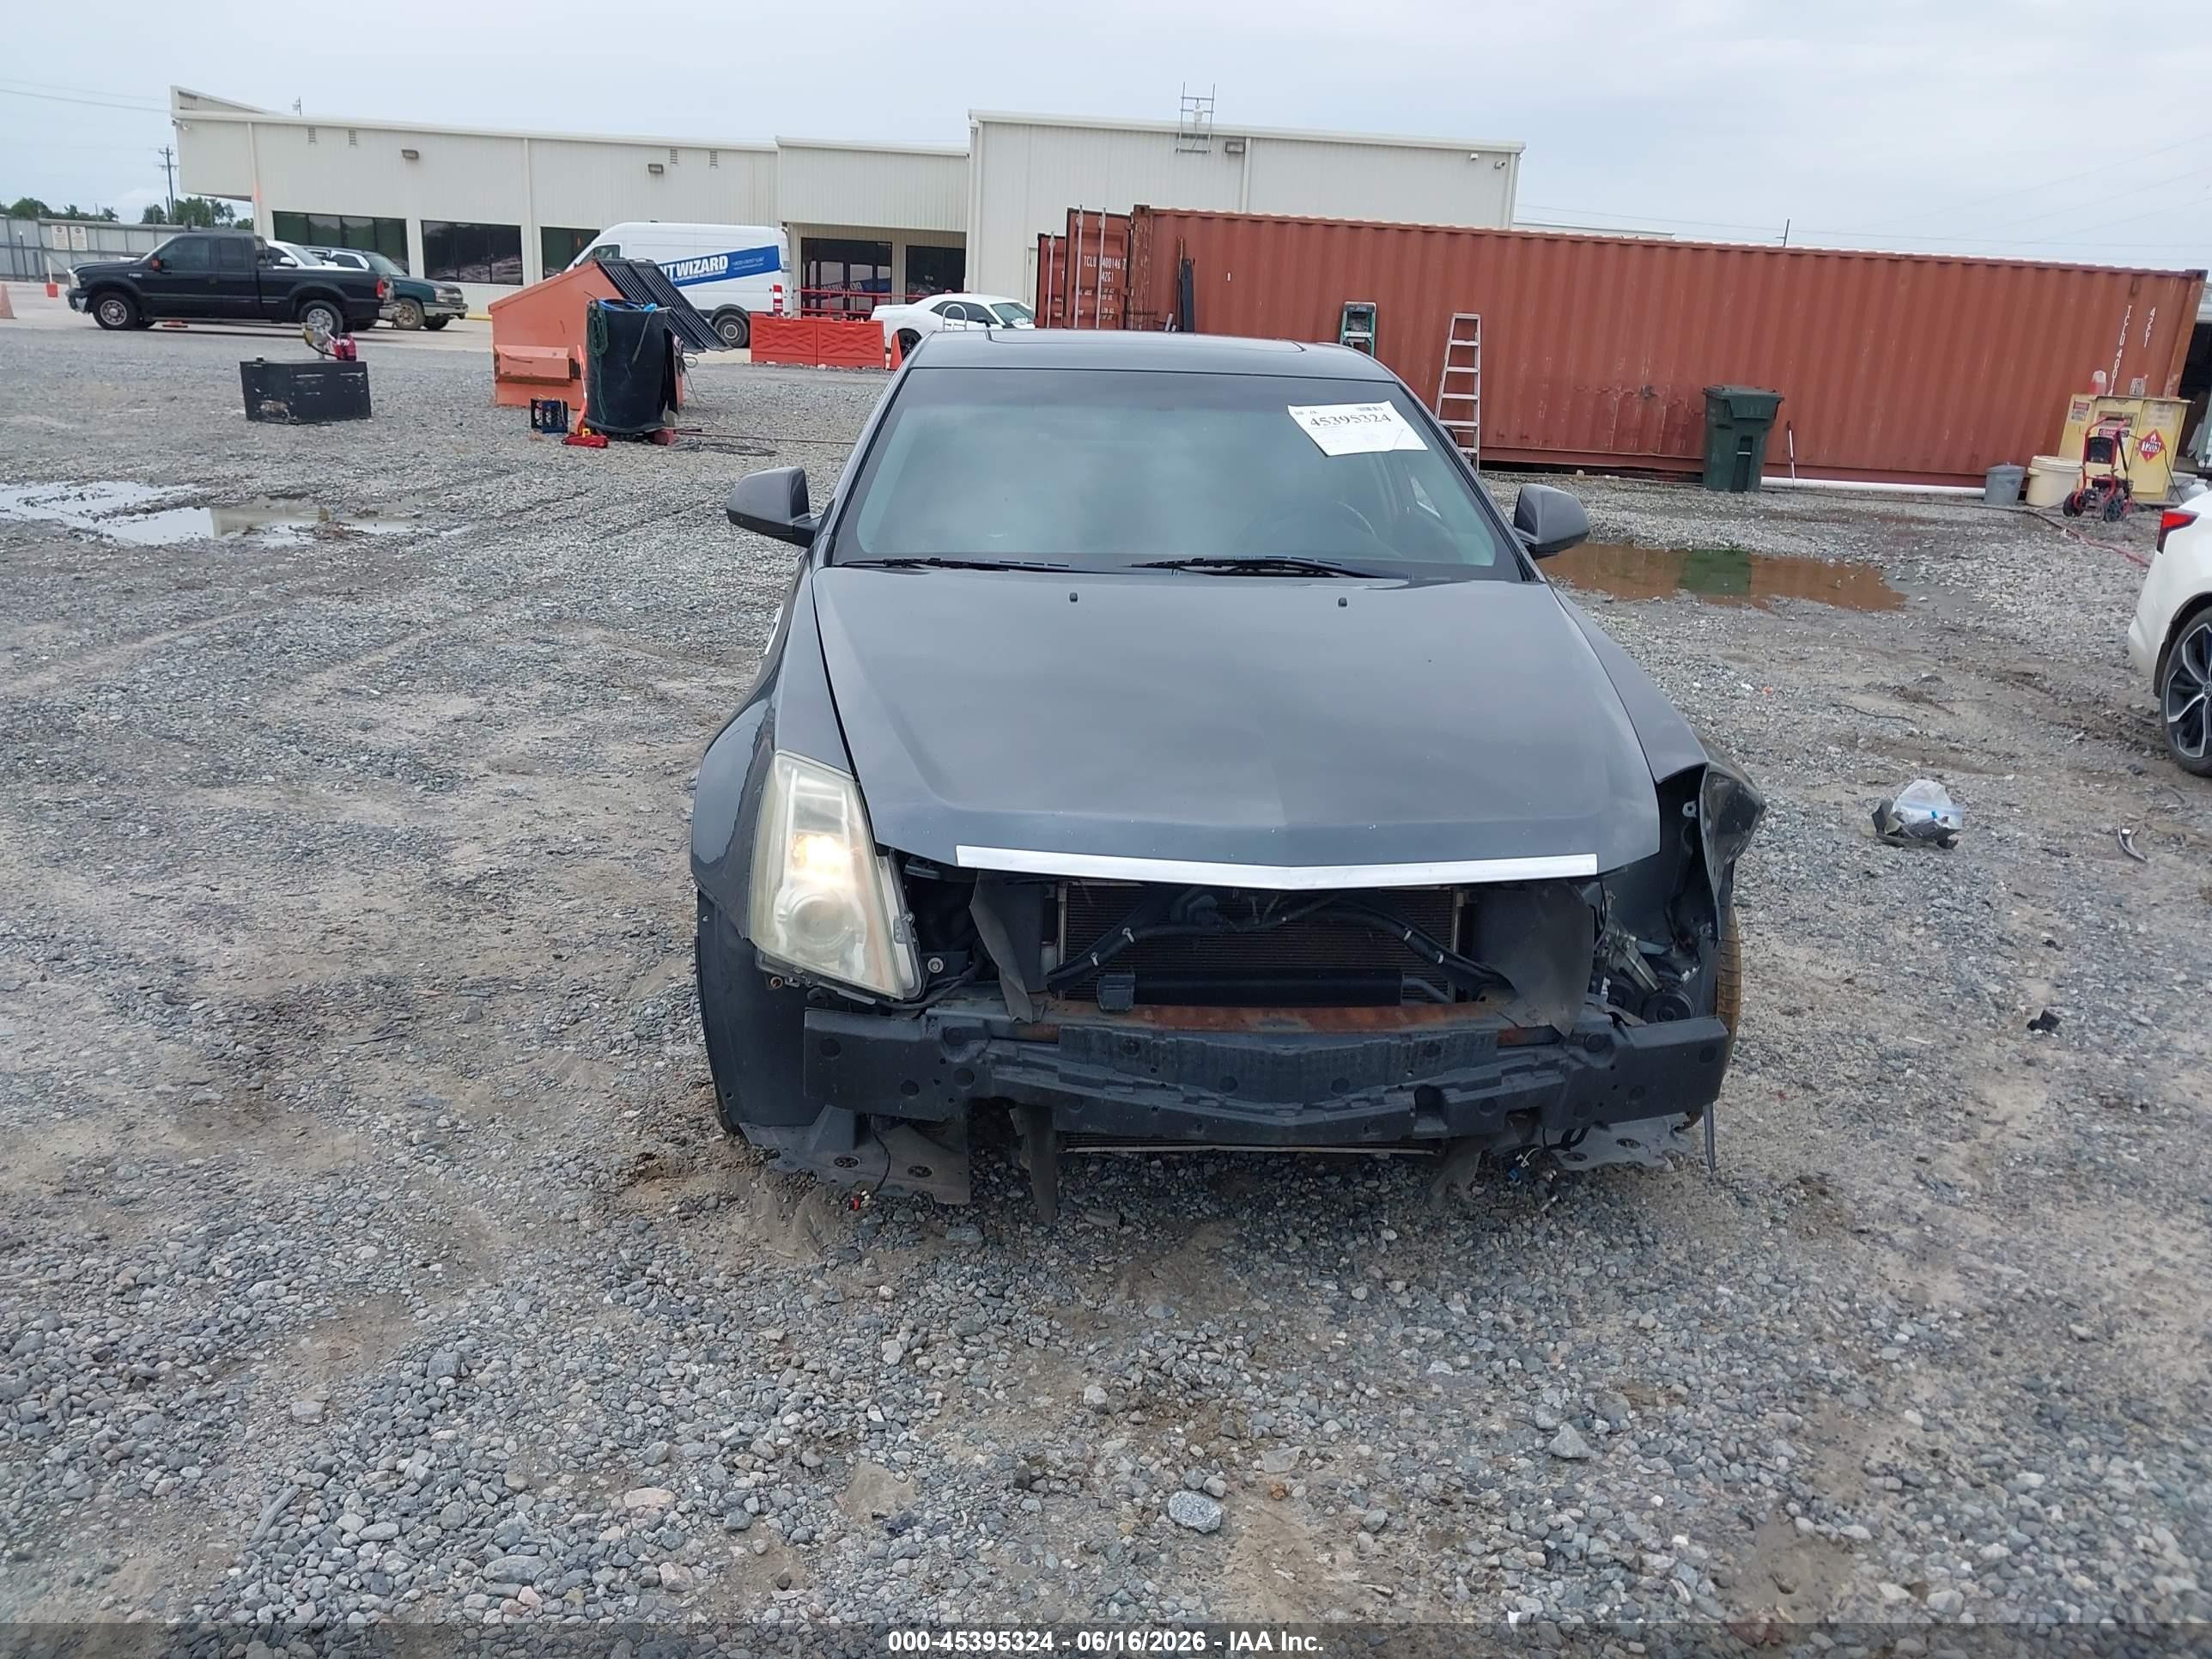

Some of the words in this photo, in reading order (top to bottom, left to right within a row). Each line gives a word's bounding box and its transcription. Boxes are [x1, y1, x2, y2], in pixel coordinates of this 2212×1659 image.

[659, 255, 728, 279] NTWIZARD
[1310, 413, 1391, 427] 45395324
[2143, 441, 2160, 453] 1203
